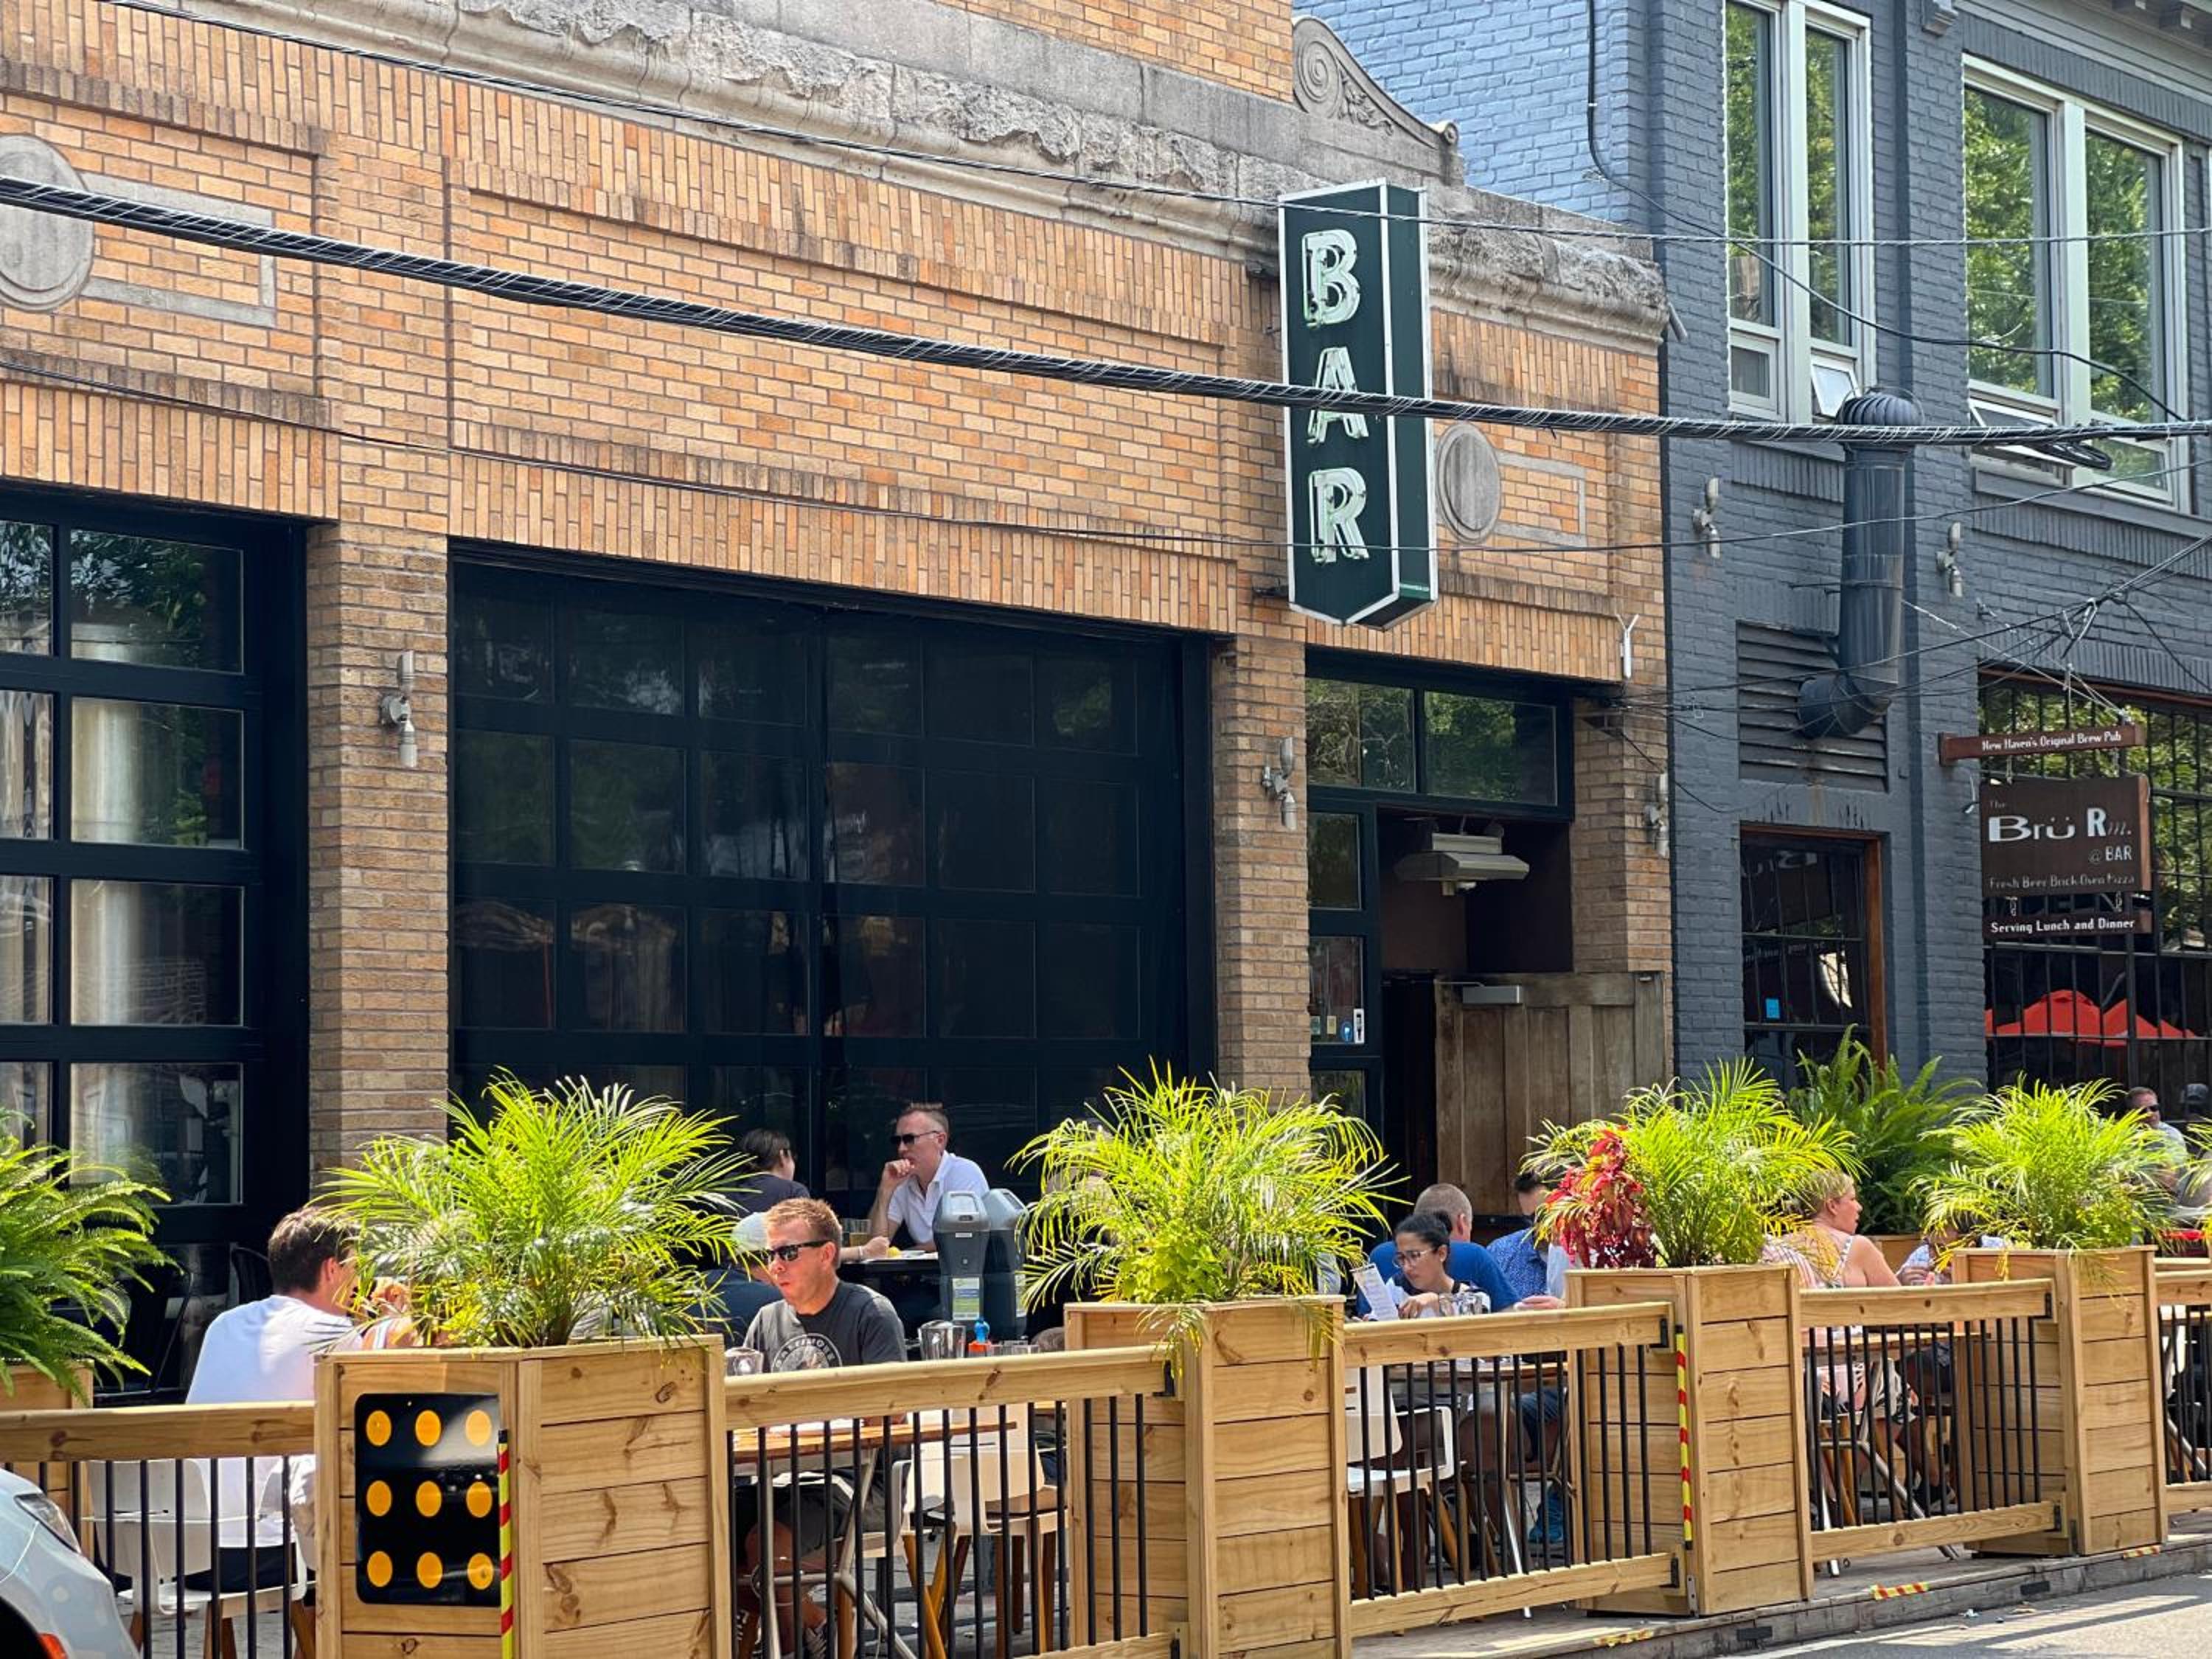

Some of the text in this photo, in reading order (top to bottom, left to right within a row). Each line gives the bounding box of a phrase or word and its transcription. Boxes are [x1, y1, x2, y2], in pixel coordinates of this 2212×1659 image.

[1302, 229, 1370, 563] BAR
[1982, 731, 2121, 751] New Haven's Original Brew Pub
[2105, 846, 2132, 861] BAR
[1989, 872, 2135, 890] Fresh Beer Brick Oven Pizza
[1991, 917, 2135, 934] Serving Lunch and Dinner
